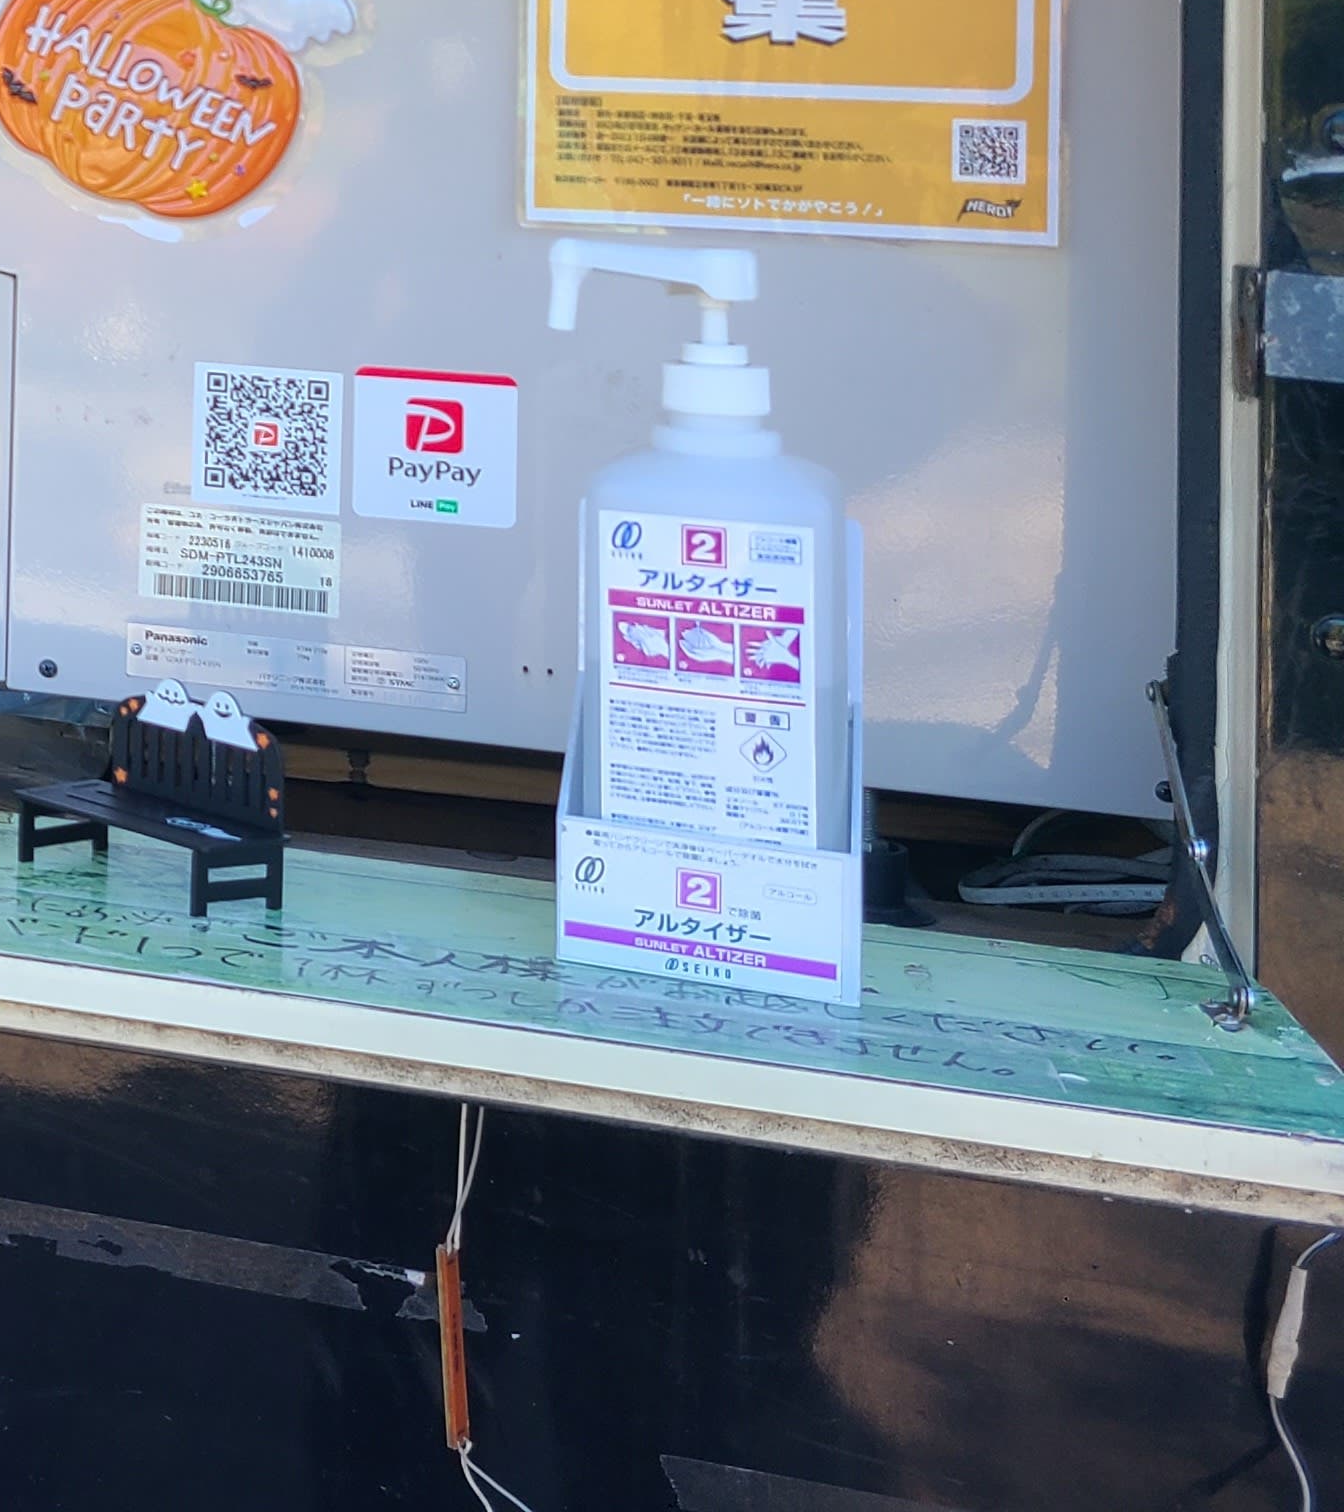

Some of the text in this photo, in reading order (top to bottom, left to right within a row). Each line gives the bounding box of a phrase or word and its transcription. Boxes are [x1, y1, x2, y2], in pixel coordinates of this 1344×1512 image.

[26, 5, 277, 147] HALLOWEEN
[387, 455, 482, 487] PayPay
[410, 498, 434, 511] LINE
[179, 547, 283, 569] SDM-PTL243SN
[690, 532, 717, 562] 2
[637, 568, 778, 597] アルタイザー
[635, 595, 777, 621] SUNLET ALTIZER
[144, 629, 209, 647] Panasonic
[685, 876, 712, 907] 2
[768, 888, 813, 903] アルコール
[633, 908, 772, 943] アルタイザー
[634, 936, 767, 968] SUNLET ALTIZER
[682, 961, 733, 980] SEIKO
